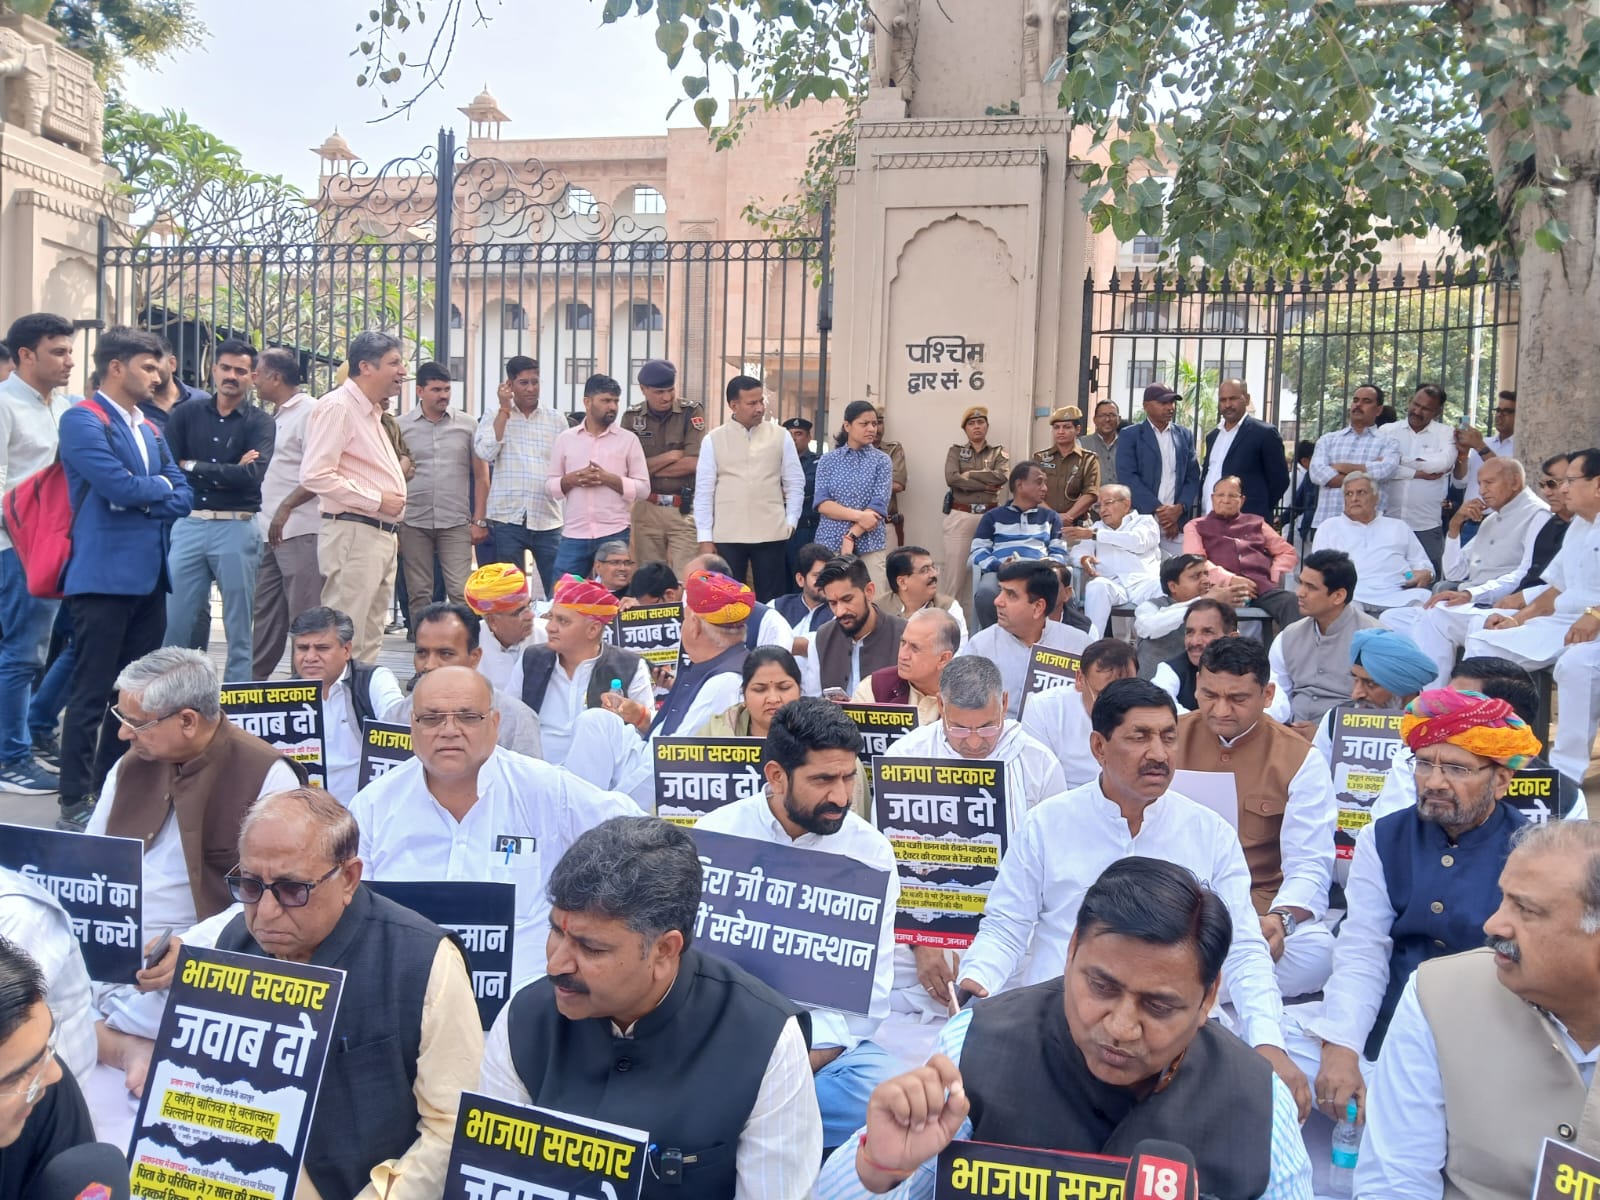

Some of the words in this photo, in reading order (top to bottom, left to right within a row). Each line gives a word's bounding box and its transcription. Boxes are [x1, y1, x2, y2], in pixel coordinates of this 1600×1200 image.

[906, 336, 984, 363] पश्चिम
[908, 373, 937, 394] द्वार
[969, 371, 984, 390] 6
[621, 610, 647, 621] भाजपा
[650, 607, 680, 619] सरकार
[623, 624, 662, 643] जवाब
[664, 618, 681, 640] दो
[1036, 651, 1071, 668] भाजपा
[219, 689, 263, 705] भाजपा
[267, 687, 316, 702] सरकार
[291, 703, 317, 734] दो
[868, 711, 914, 725] सरकार
[1343, 714, 1386, 729] भाजपा
[369, 730, 413, 750] भाजपा
[658, 745, 704, 761] भाजपा
[707, 746, 761, 762] सरकार
[660, 772, 729, 800] जवाब
[732, 765, 761, 798] दो
[882, 764, 932, 783] भाजपा
[935, 767, 996, 786] सरकार
[1504, 778, 1552, 796] रकार
[884, 793, 960, 825] जवाब
[964, 788, 996, 827] दो
[108, 883, 138, 908] का
[735, 866, 765, 902] जी
[766, 878, 797, 908] का
[799, 885, 881, 924] अपमान
[93, 916, 138, 947] करो
[710, 909, 770, 950] सहेगा
[773, 926, 875, 971] राजस्थान
[182, 959, 250, 996] भाजपा
[251, 970, 330, 1010] सरकार
[171, 1005, 271, 1068] जवाब
[272, 1012, 317, 1077] दो
[163, 1103, 193, 1121] चिल्लाने
[196, 1112, 206, 1123] पर
[208, 1115, 224, 1128] गला
[226, 1117, 253, 1135] घोंटकर
[256, 1125, 274, 1139] हत्या
[167, 1092, 171, 1103] 7
[174, 1092, 195, 1106] वर्षीय
[197, 1097, 226, 1113] बालिका
[229, 1103, 236, 1116] से
[239, 1106, 275, 1126] बलात्कार,
[466, 1109, 541, 1156] भाजपा
[542, 1126, 635, 1179] सरकार
[132, 1182, 139, 1195] से
[136, 1163, 155, 1180] पिता
[157, 1169, 167, 1183] के
[168, 1172, 197, 1190] परिचित
[198, 1179, 206, 1193] ने
[207, 1184, 213, 1194] 7
[215, 1186, 232, 1200] साल
[952, 1158, 1051, 1200] भाजपा
[1141, 1165, 1177, 1200] 18
[1555, 1163, 1600, 1200] भा
